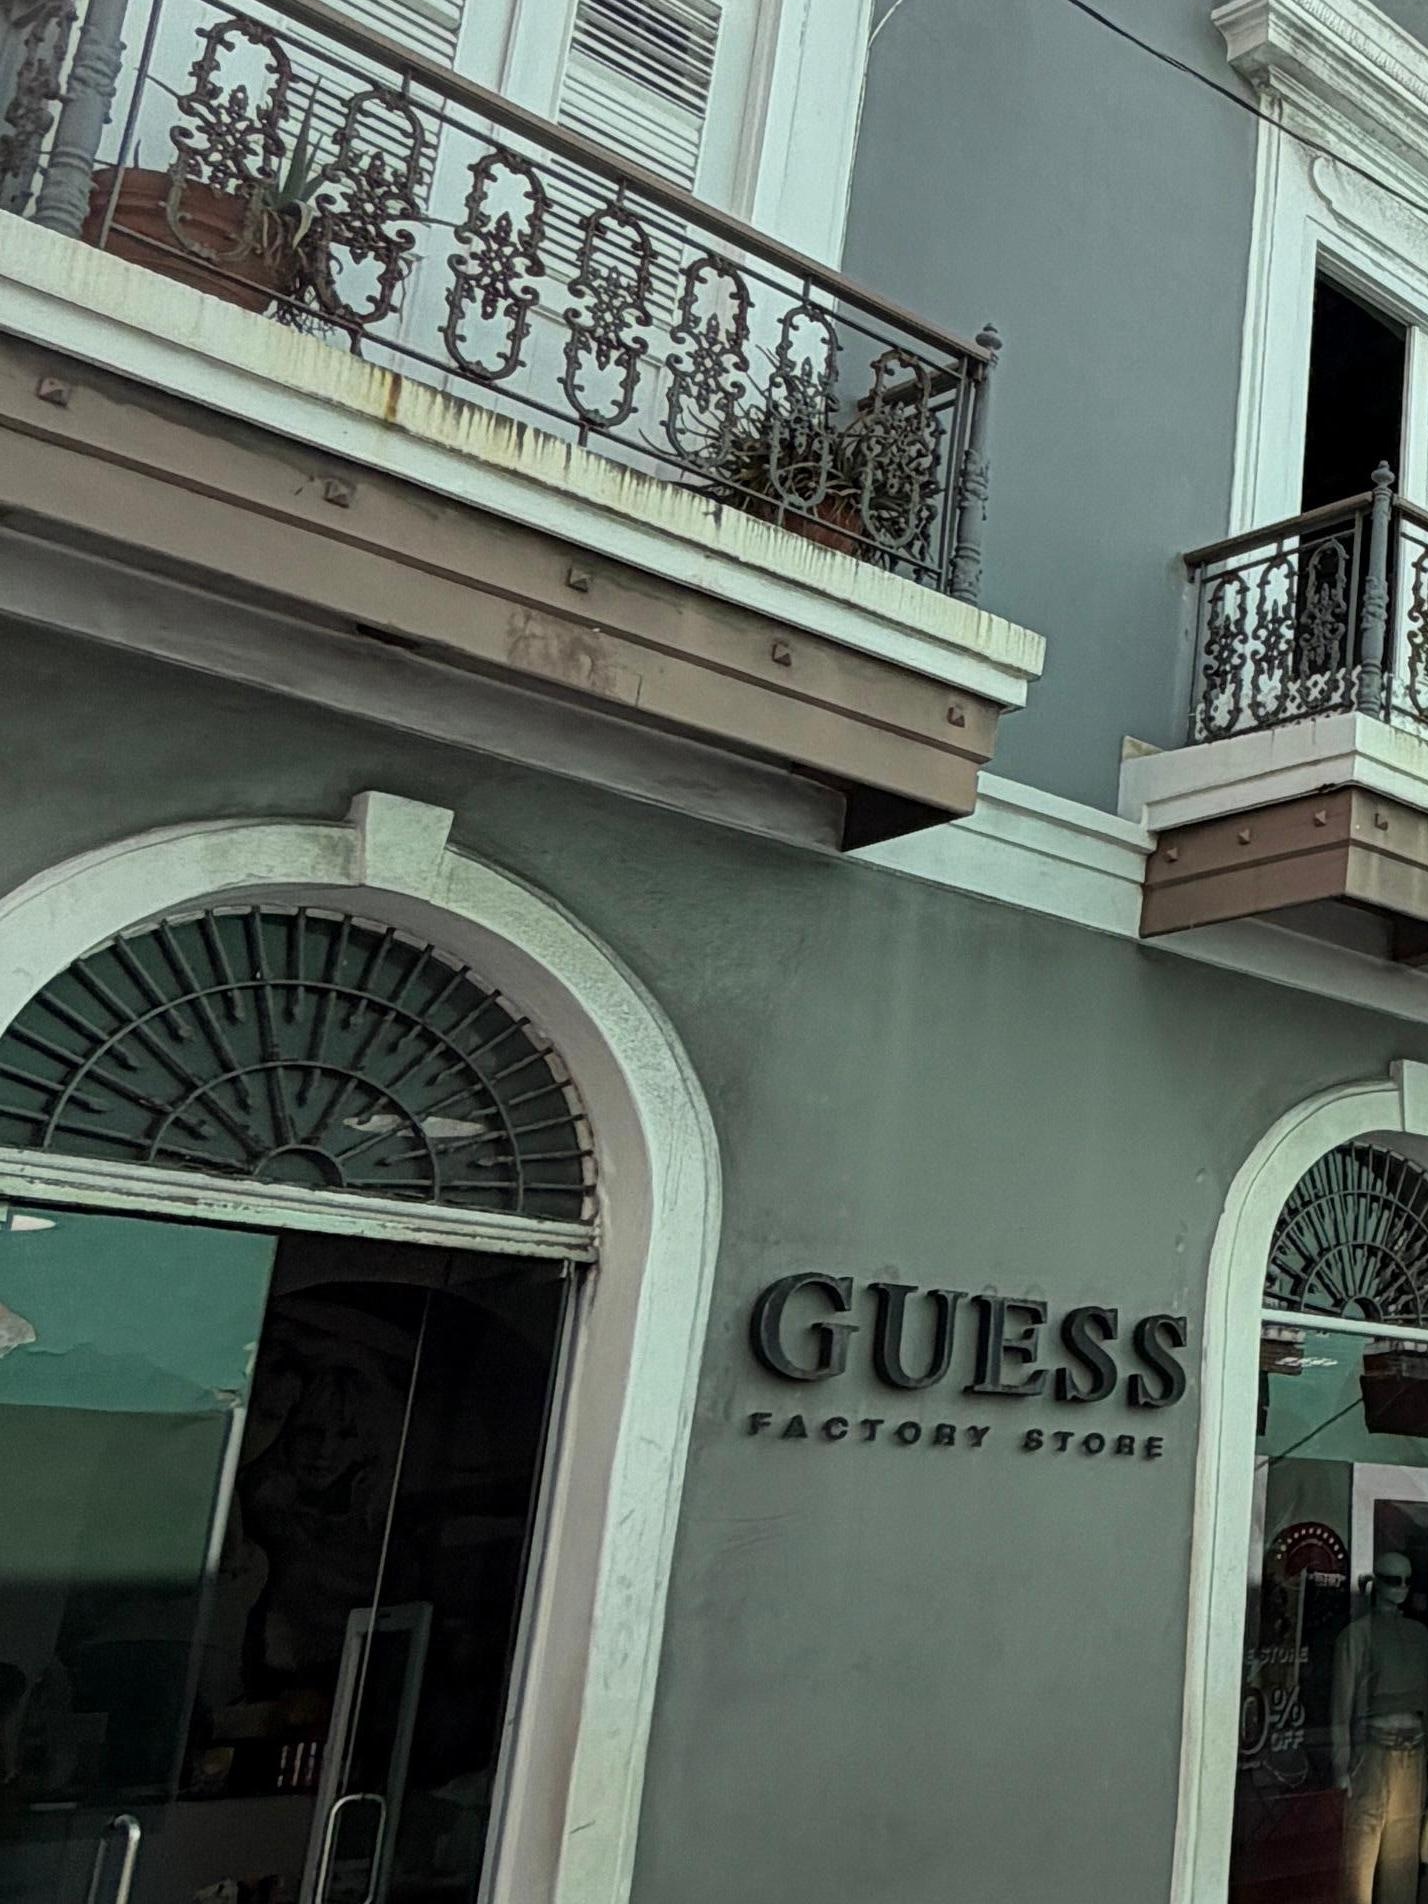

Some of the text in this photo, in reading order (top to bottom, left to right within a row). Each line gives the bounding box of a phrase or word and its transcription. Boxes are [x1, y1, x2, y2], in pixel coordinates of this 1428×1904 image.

[748, 1271, 1188, 1409] GUESS
[747, 1411, 1164, 1460] FACTORY STORE
